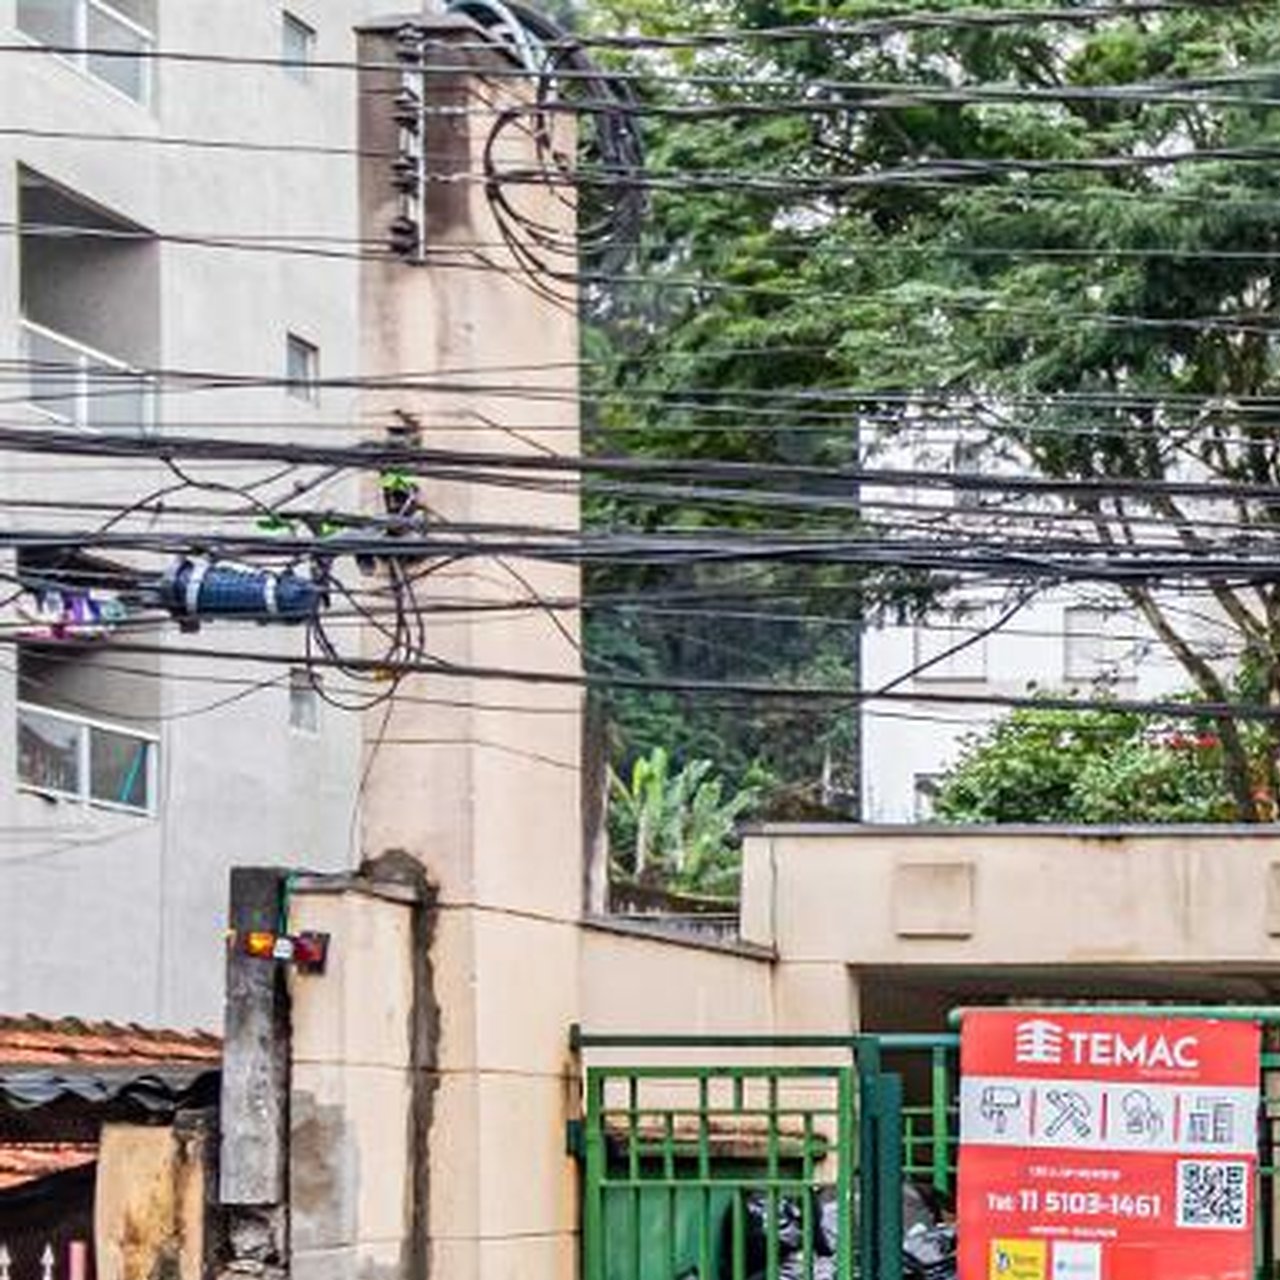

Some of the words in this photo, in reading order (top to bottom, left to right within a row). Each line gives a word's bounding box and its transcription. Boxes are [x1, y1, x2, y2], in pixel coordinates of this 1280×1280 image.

[1066, 1032, 1199, 1068] TEMAC
[1019, 1188, 1039, 1213] 11
[1045, 1190, 1162, 1218] 5103-1461
